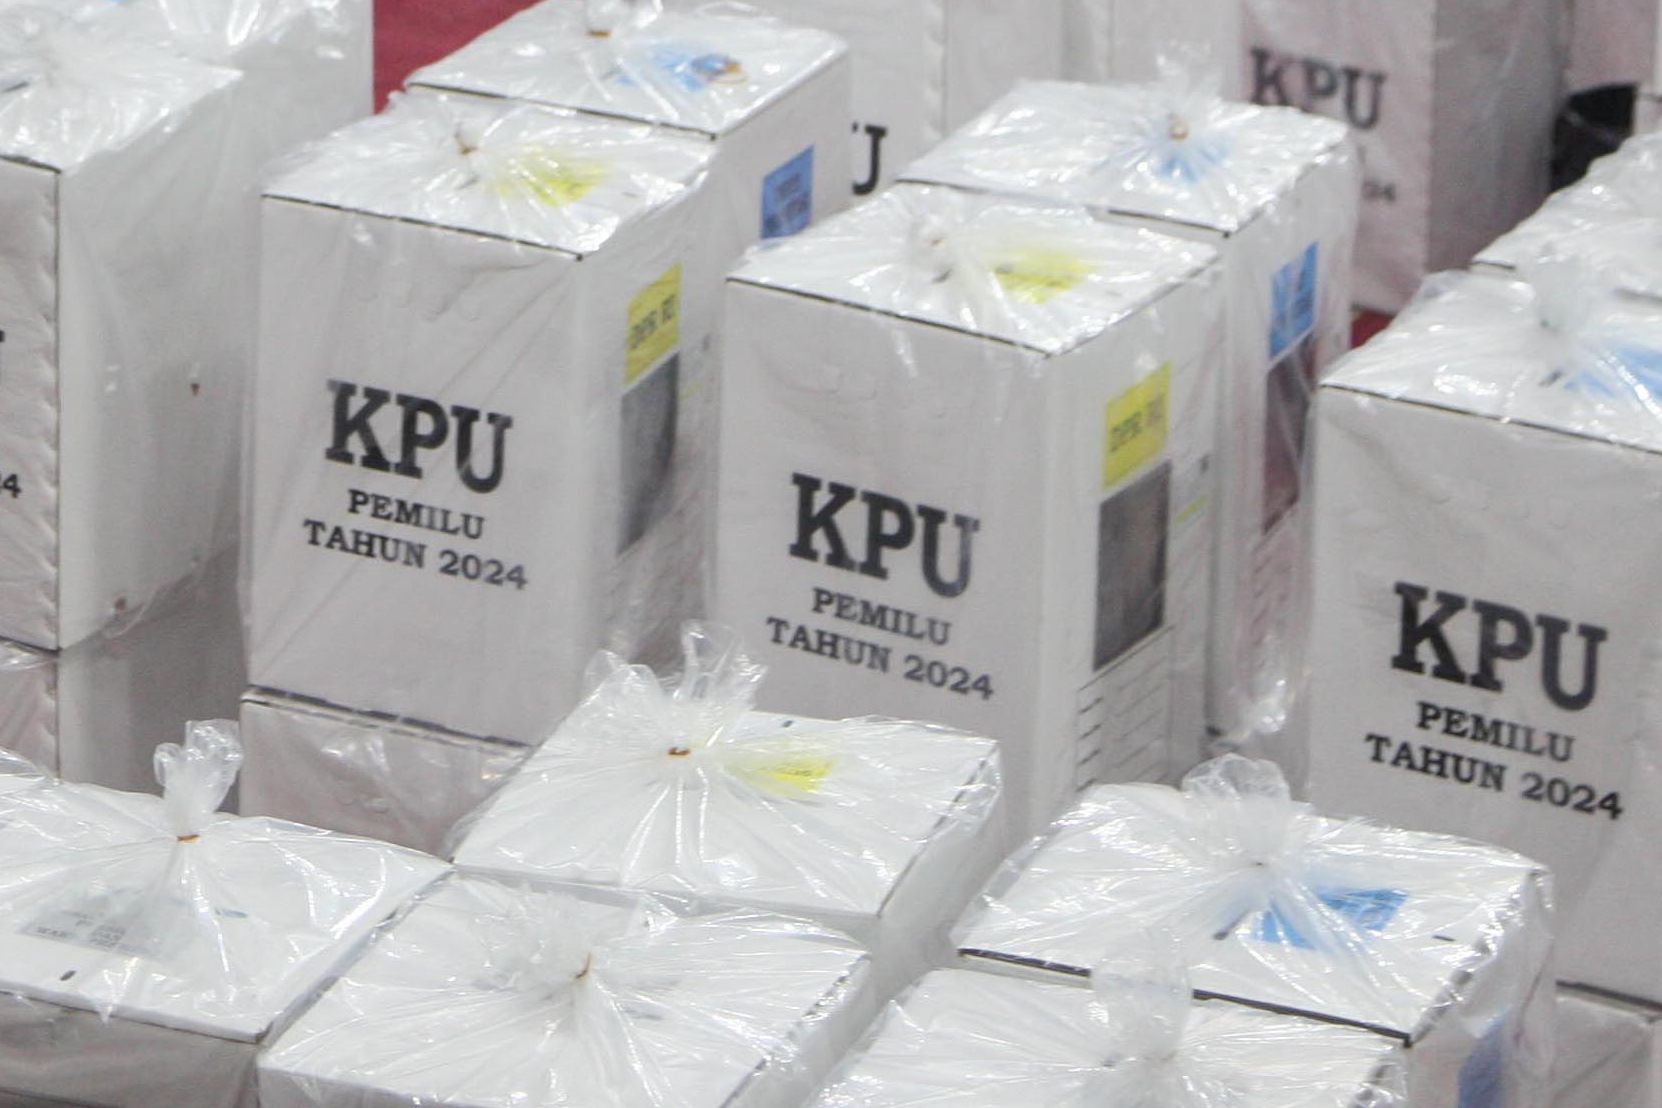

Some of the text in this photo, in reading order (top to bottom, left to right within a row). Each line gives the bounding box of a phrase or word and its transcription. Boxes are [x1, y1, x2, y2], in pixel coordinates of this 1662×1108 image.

[1251, 49, 1387, 132] KPU
[325, 380, 512, 494] KPU
[303, 519, 528, 590] TAHUN 2024
[348, 489, 485, 540] PEMILU
[789, 472, 980, 598] KPU
[812, 587, 953, 646] PEMILU
[1392, 582, 1609, 712] KPU
[766, 618, 994, 700] TAHUN 2024
[1418, 701, 1577, 763] PEMILU
[1365, 732, 1624, 821] TAHUN 2024
